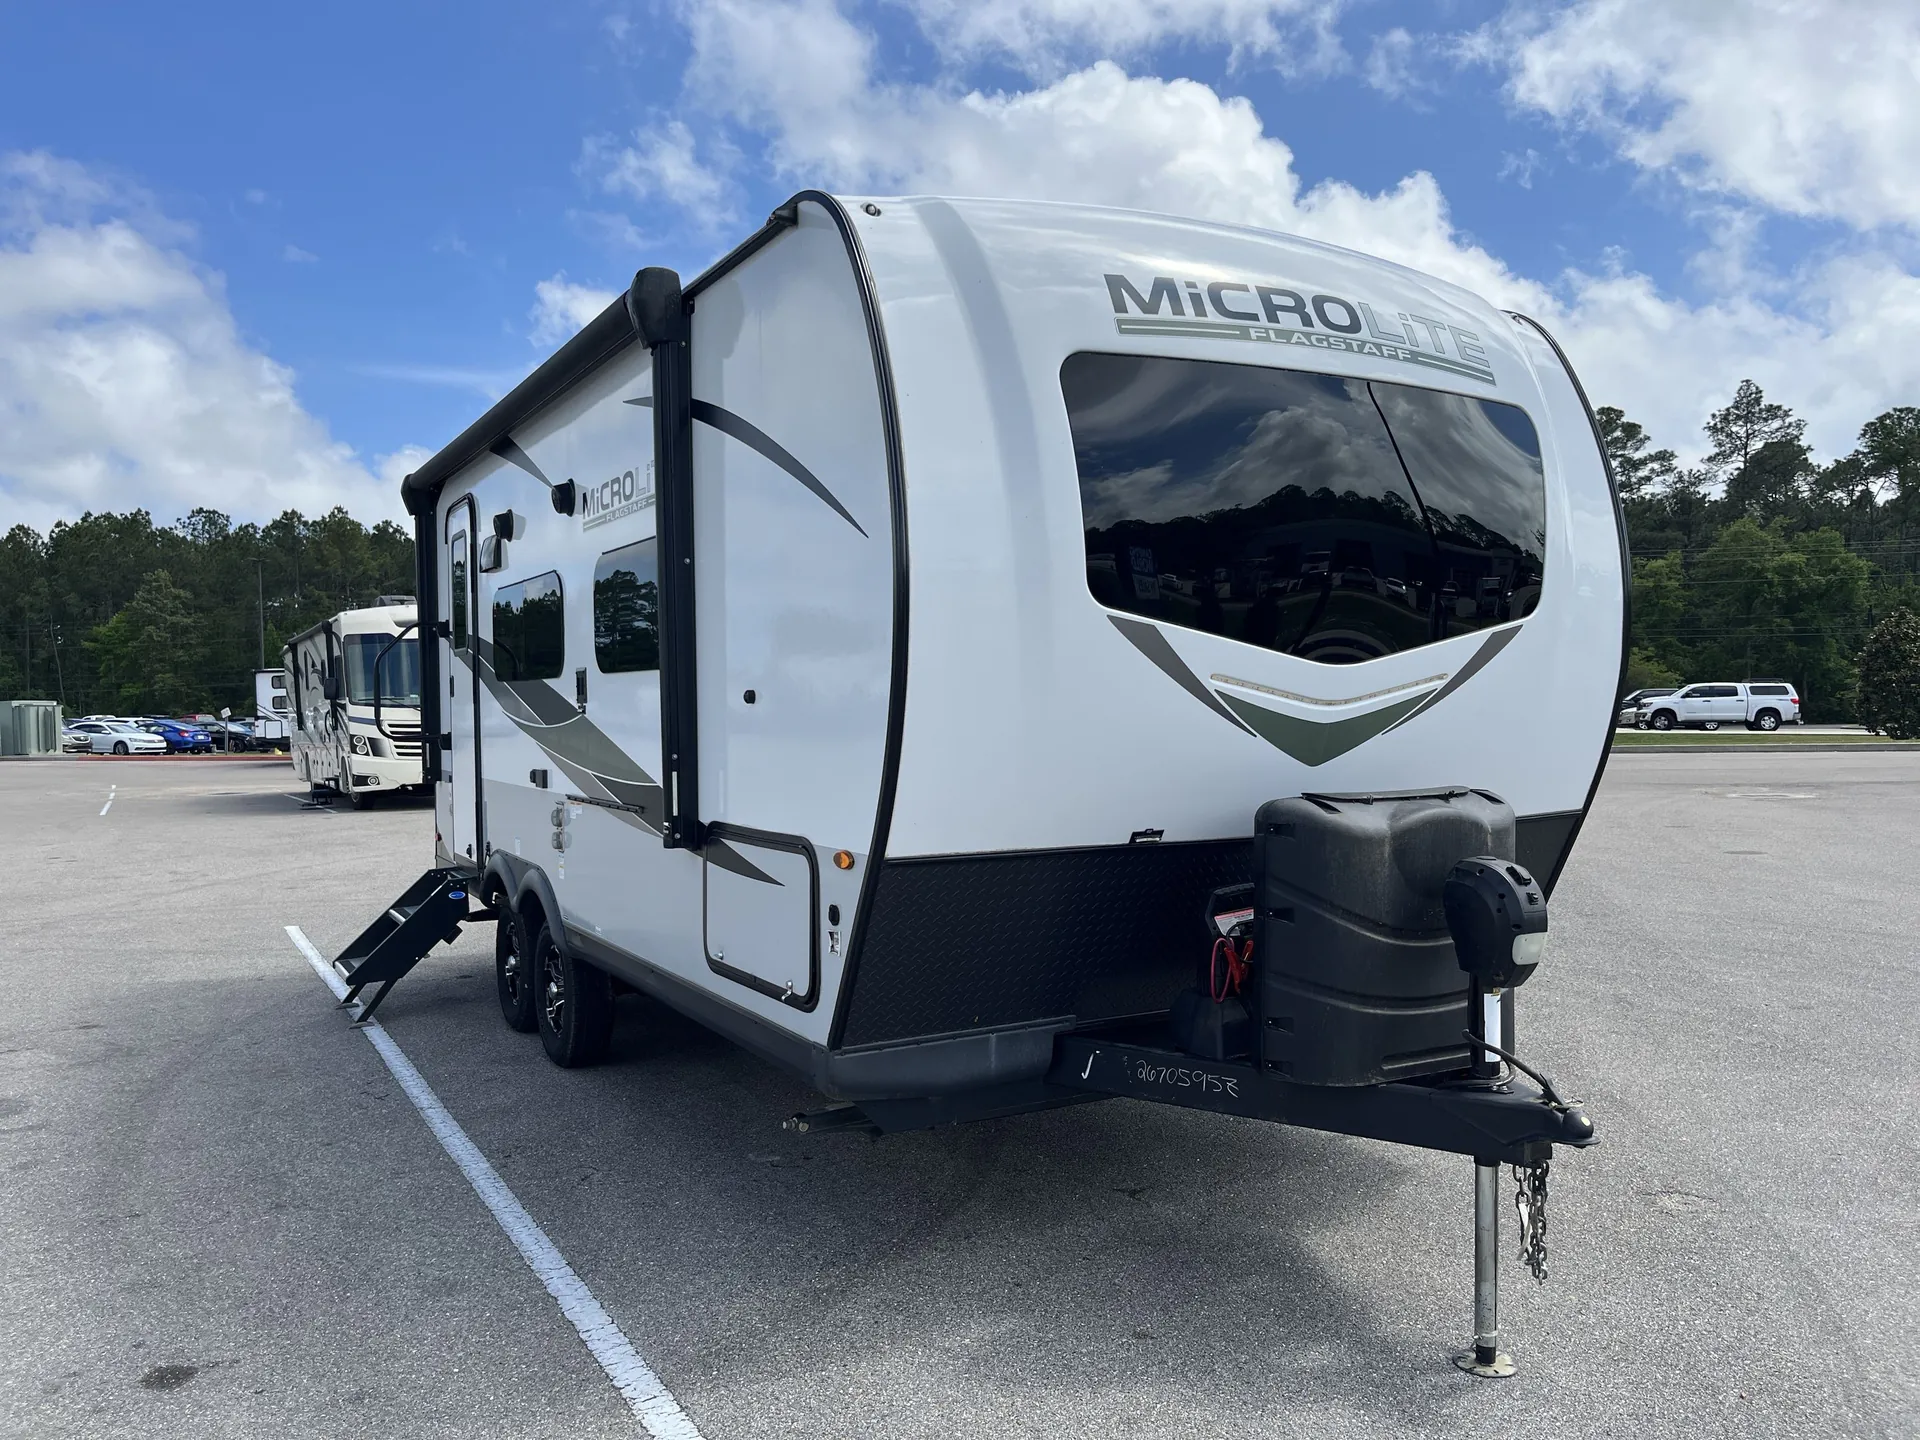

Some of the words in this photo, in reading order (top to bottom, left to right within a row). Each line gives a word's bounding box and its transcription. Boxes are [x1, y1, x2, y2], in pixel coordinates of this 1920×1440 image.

[1103, 273, 1491, 368] MiCROLiTE
[1249, 327, 1412, 361] FLAGSTAFF
[582, 459, 656, 519] MiCROLi
[606, 500, 648, 522] FLAGSTAFF
